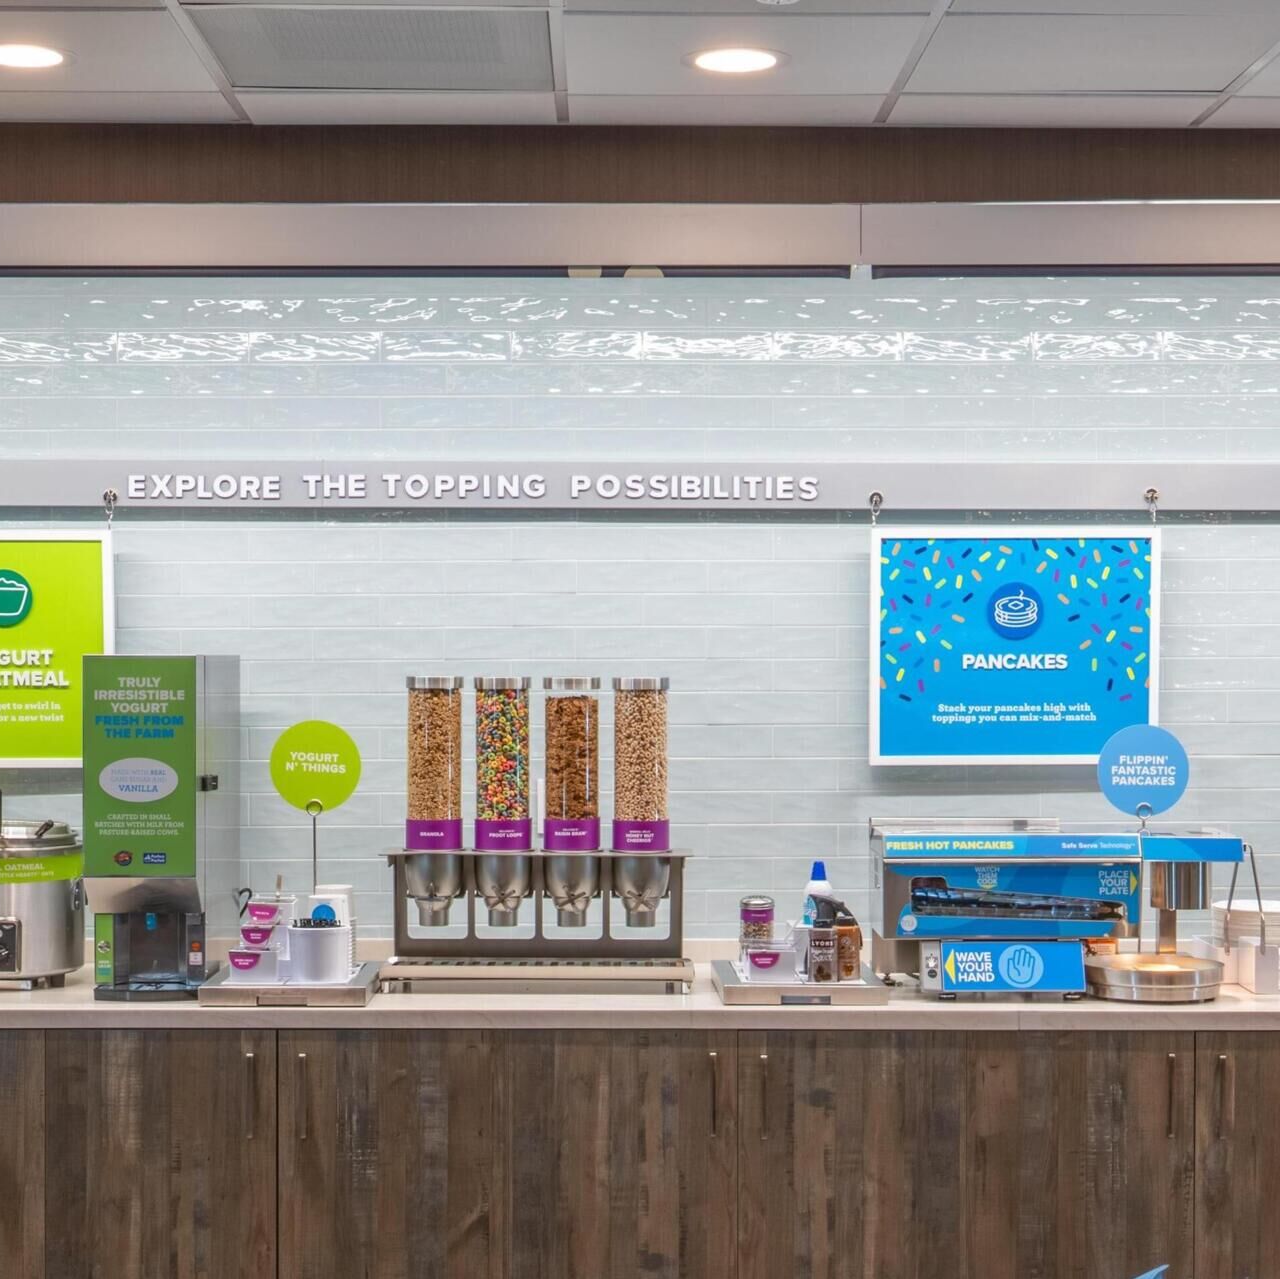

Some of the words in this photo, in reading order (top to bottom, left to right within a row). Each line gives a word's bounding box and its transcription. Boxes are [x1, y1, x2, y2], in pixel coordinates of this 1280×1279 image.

[127, 474, 282, 500] EXPLORE
[302, 474, 368, 499] THE
[382, 474, 548, 499] TOPPING
[570, 474, 820, 500] POSSIBILITIES
[962, 653, 1069, 670] PANCAKES
[118, 677, 161, 688] TRULY
[94, 689, 185, 700] IRRESISTIBLE
[12, 702, 23, 710] to
[24, 701, 49, 710] swirl
[50, 701, 61, 710] in
[110, 702, 169, 713] YOGURT
[937, 703, 966, 713] Stack
[968, 705, 992, 714] your
[994, 703, 1041, 714] pancakes
[1043, 703, 1066, 714] high
[1068, 703, 1091, 712] with
[39, 714, 64, 722] twist
[95, 715, 139, 725] FRESH
[143, 715, 185, 725] FROM
[932, 714, 976, 724] toppings
[979, 715, 997, 724] you
[1019, 712, 1097, 722] mix-and-match
[105, 728, 131, 738] THE
[135, 728, 175, 738] FARM
[290, 752, 339, 763] YOGURT
[1119, 755, 1168, 766] FLIPPIN'
[285, 761, 298, 771] N'
[302, 762, 346, 774] THINGS
[1111, 766, 1176, 776] FANTASTIC
[1111, 776, 1175, 787] PANCAKES
[886, 841, 923, 850] FRESH
[925, 841, 949, 850] HOT
[952, 840, 1014, 850] PANCAKES
[4, 863, 45, 871] OATMEAL
[1098, 870, 1129, 879] PLACE
[1099, 878, 1128, 887] YOUR
[1099, 886, 1129, 896] PLATE
[955, 951, 992, 962] WAVE
[957, 961, 992, 972] YOUR
[958, 971, 995, 983] HAND
